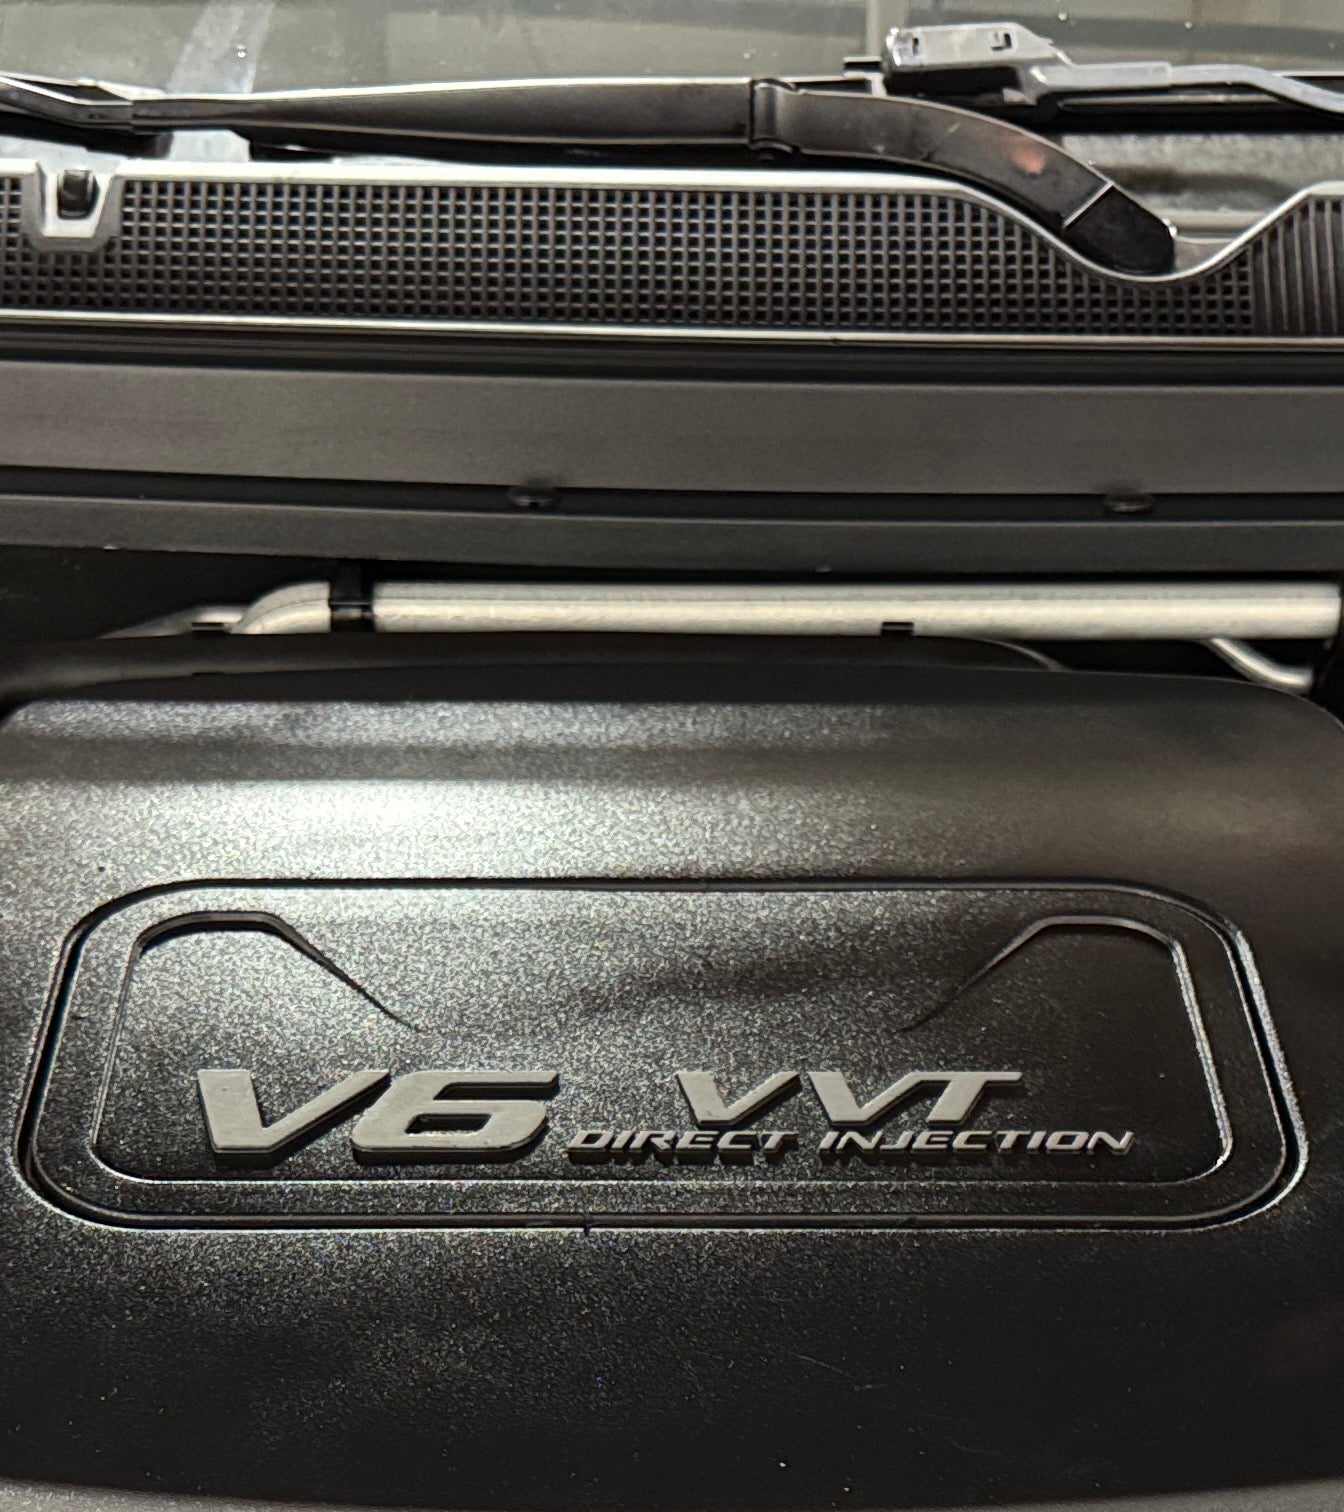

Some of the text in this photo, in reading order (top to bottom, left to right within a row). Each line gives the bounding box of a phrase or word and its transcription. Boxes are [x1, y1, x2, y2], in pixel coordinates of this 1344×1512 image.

[197, 1069, 1023, 1154] V6 VVT
[567, 1129, 1135, 1155] DIRECT INJECTION
